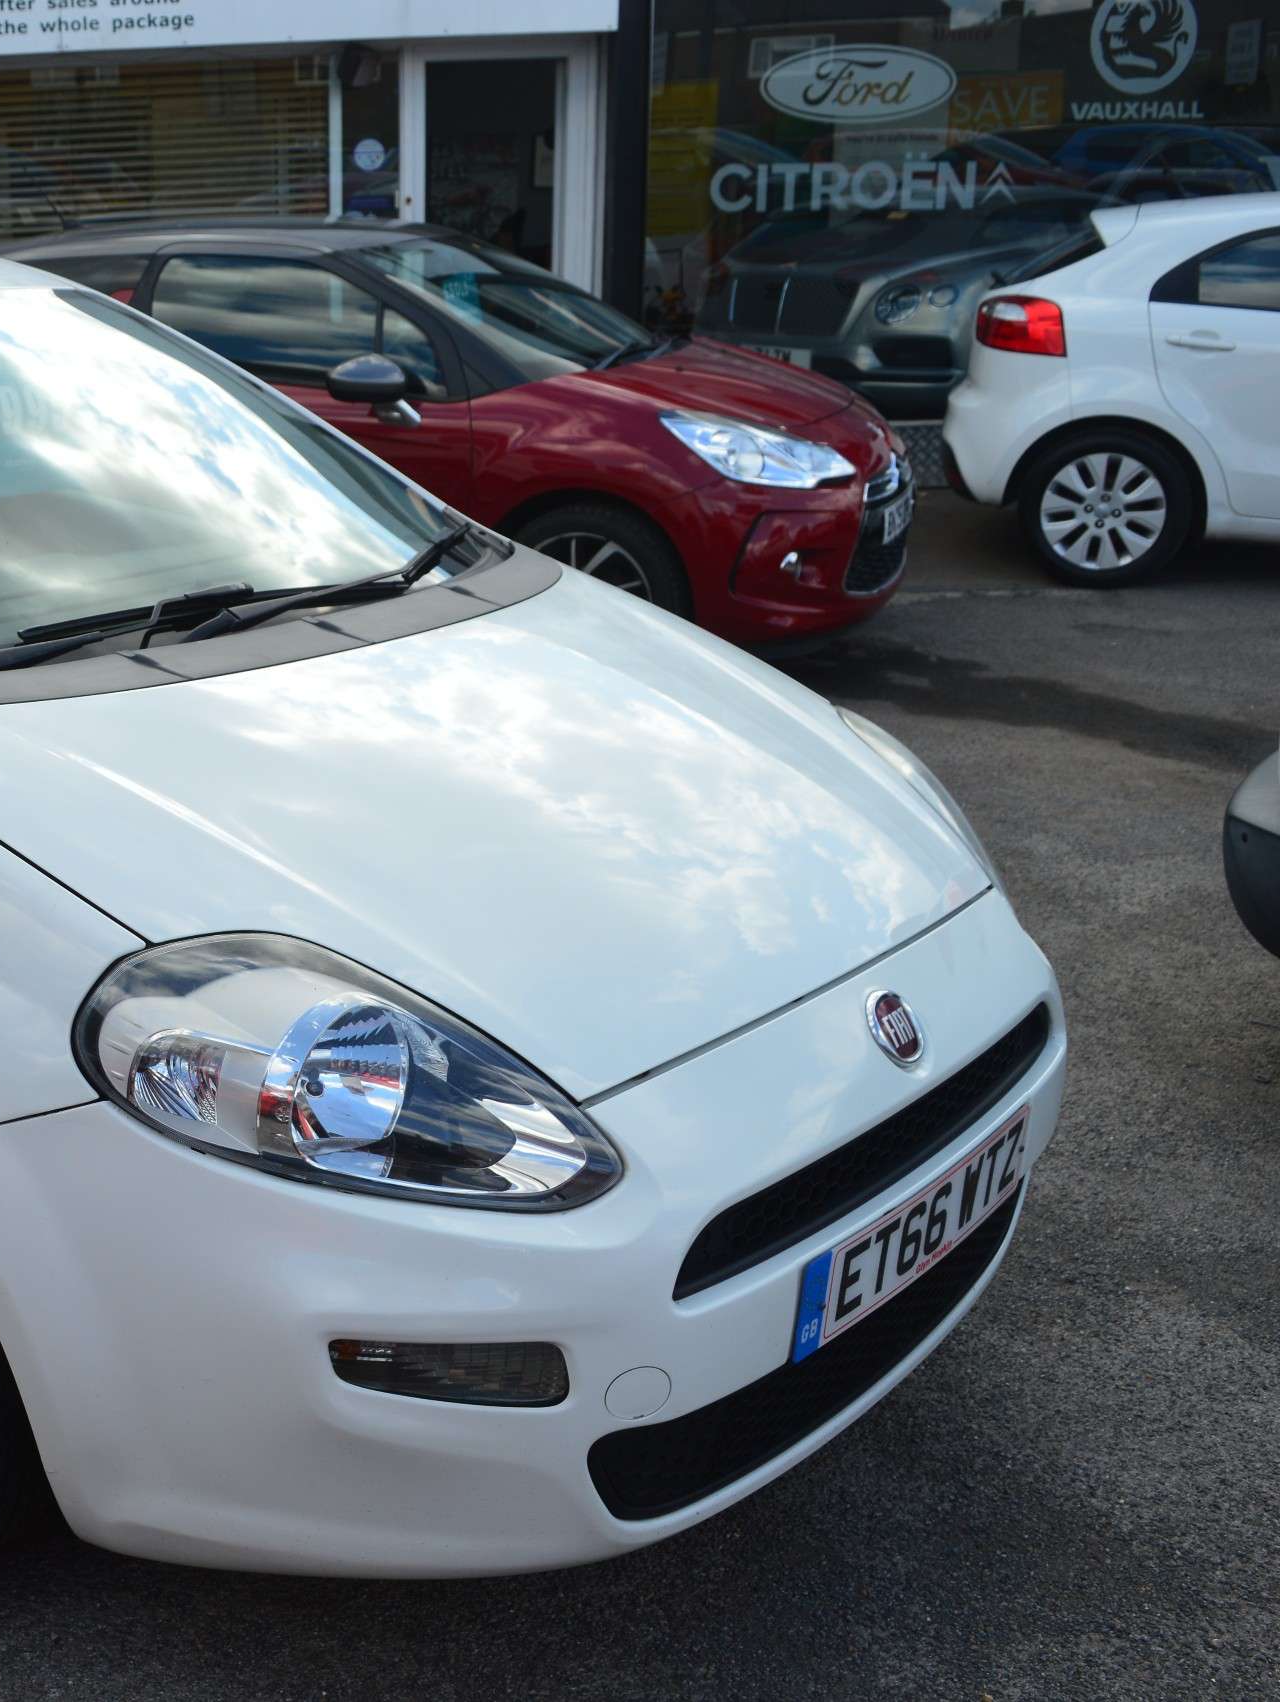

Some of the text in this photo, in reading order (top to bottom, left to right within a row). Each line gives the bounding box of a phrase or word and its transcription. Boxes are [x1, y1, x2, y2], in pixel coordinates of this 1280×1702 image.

[40, 16, 99, 32] whole
[112, 13, 194, 32] package
[802, 57, 915, 106] Ford
[950, 83, 1050, 124] SAVE
[1072, 100, 1205, 120] VAUXHALL
[710, 152, 977, 213] CITROËN
[882, 1006, 915, 1049] FIAT
[835, 1118, 1025, 1321] ET66 WTZ
[801, 1318, 819, 1344] GB
